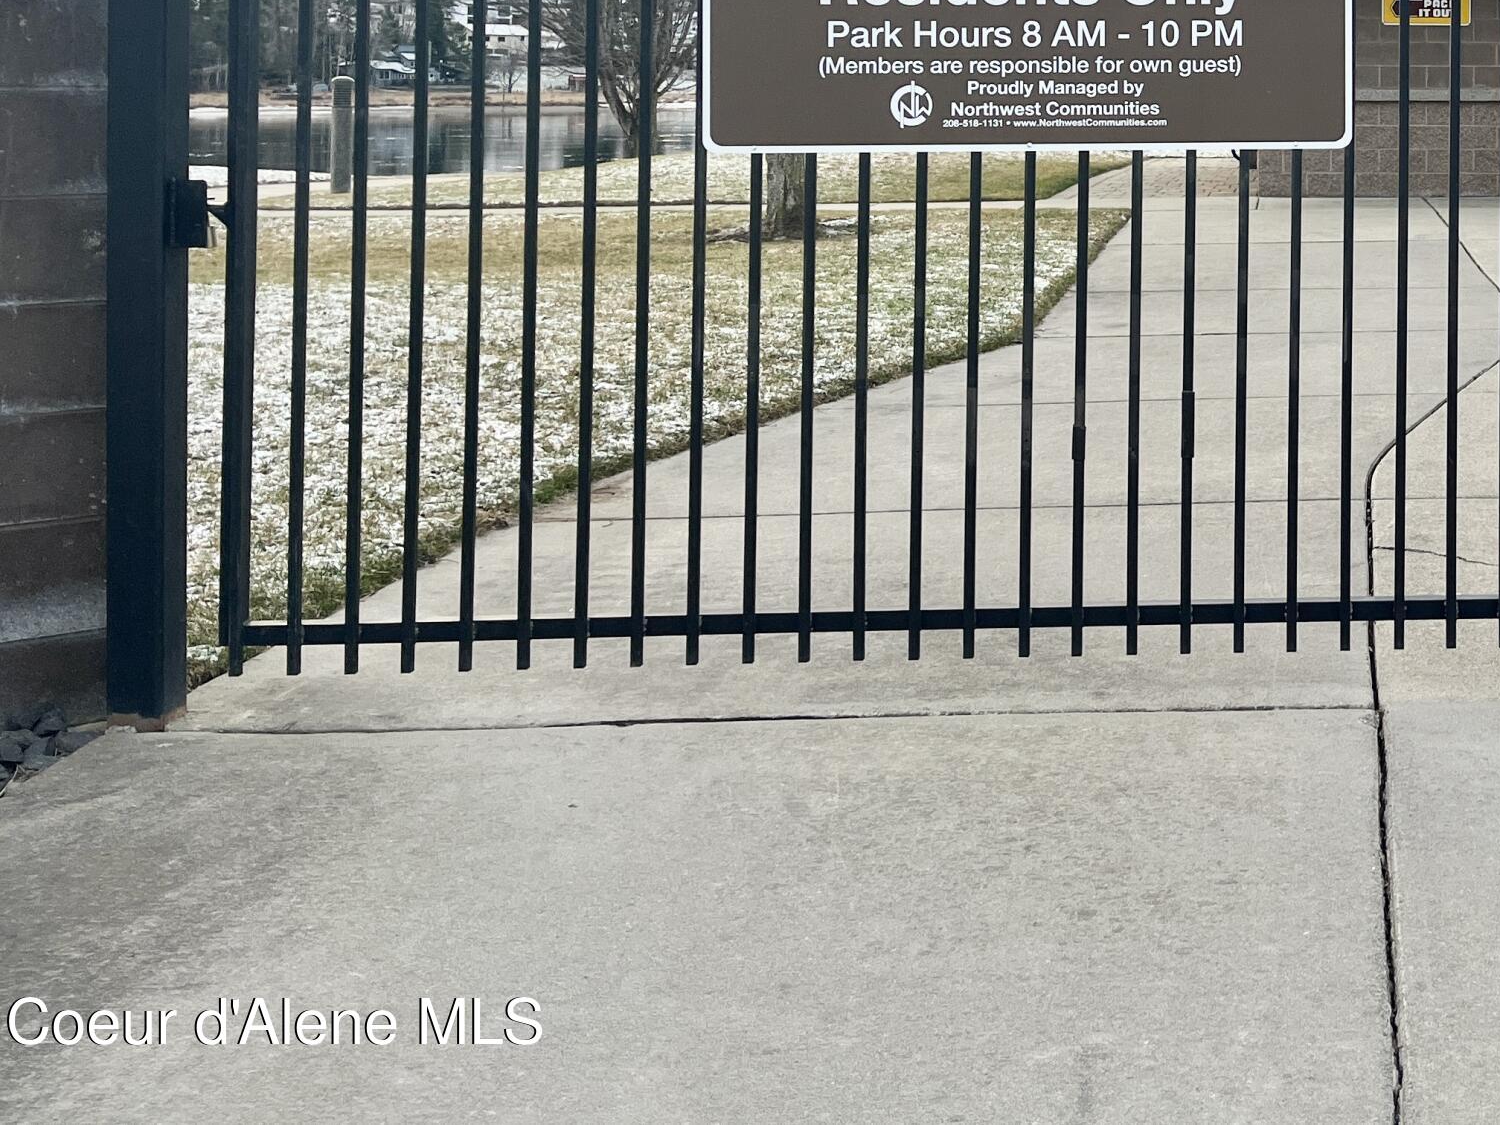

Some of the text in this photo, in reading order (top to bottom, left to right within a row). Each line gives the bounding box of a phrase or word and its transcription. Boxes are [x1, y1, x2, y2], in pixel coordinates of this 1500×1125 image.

[1424, 0, 1452, 8] PAC
[828, 21, 903, 47] Park
[915, 21, 1011, 47] Hours
[1023, 21, 1041, 47] 8
[1051, 21, 1105, 46] AM
[1142, 21, 1179, 46] 10
[1192, 20, 1242, 46] PM
[819, 55, 1241, 78] (Members are responsible for own guest)
[968, 80, 1144, 97] Proudly Managed by
[952, 101, 1159, 116] Northwest Communities
[1013, 118, 1167, 126] www.NorthwestCommunities.com
